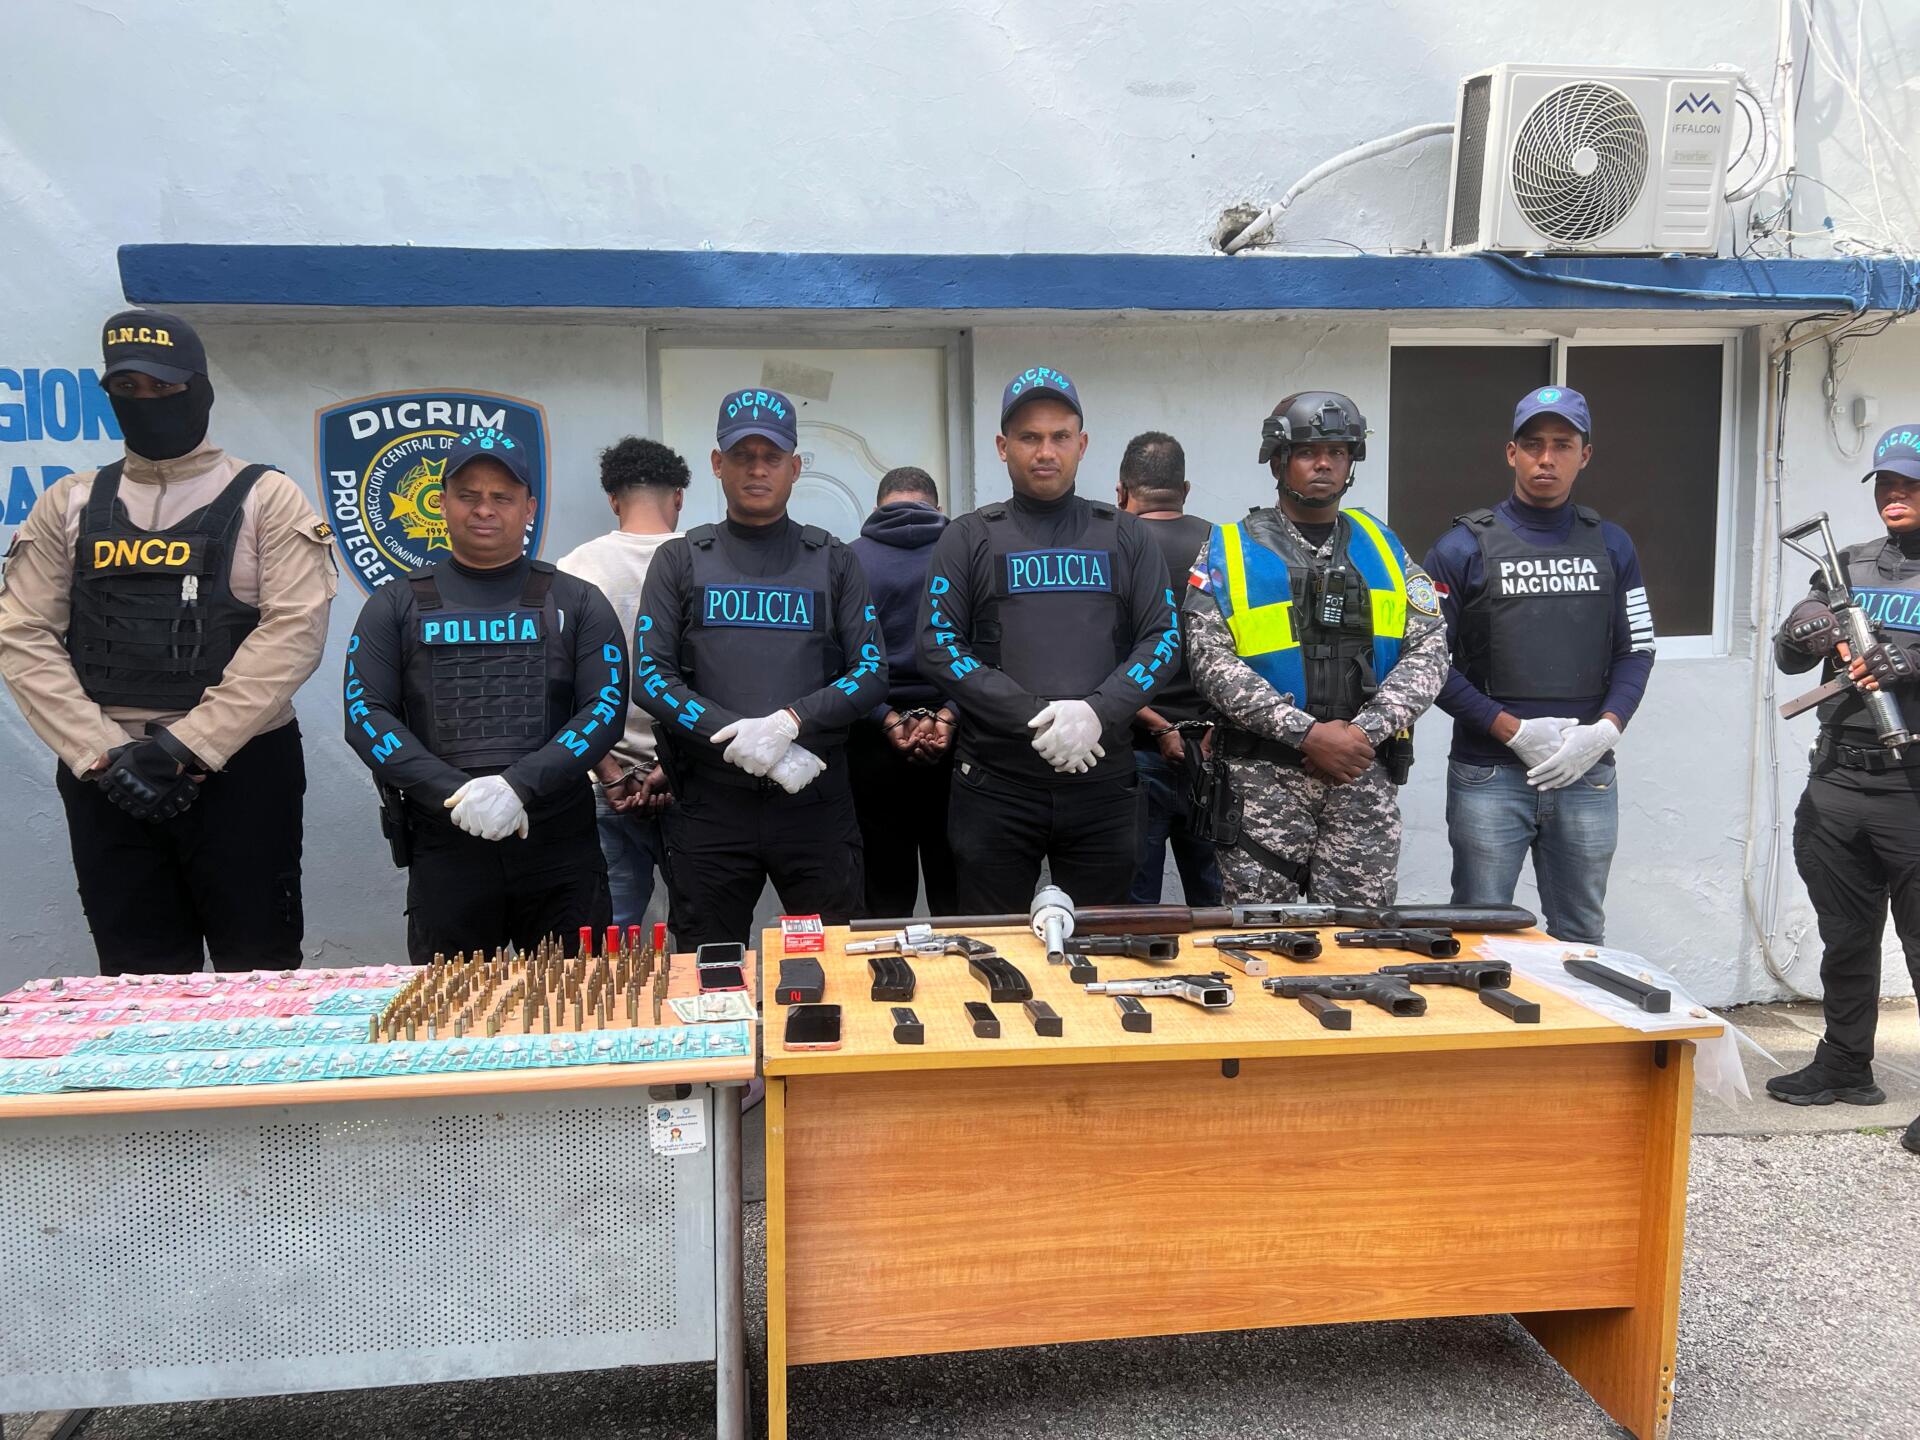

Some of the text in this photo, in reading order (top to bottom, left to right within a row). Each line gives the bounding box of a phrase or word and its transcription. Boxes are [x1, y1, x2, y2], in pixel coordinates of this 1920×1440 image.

[106, 327, 174, 346] D.N.C.D.
[1010, 367, 1070, 395] DICRIM
[348, 401, 507, 440] DICRIM
[727, 391, 786, 420] DICRIM
[382, 437, 436, 468] CENTRAL
[460, 427, 516, 450] DICRIM
[93, 539, 190, 568] DNCD
[1500, 557, 1598, 577] POLICÍA
[1011, 554, 1106, 588] POLICIA
[1501, 576, 1601, 595] NACIONAL
[707, 590, 811, 624] POLICIA
[1853, 592, 1920, 625] OLICIA
[425, 613, 538, 643] POLICÍA
[929, 576, 980, 680] DICRIM
[638, 615, 706, 730] DICRIM
[345, 635, 403, 764] DICRIM
[556, 643, 623, 758] DICRIM
